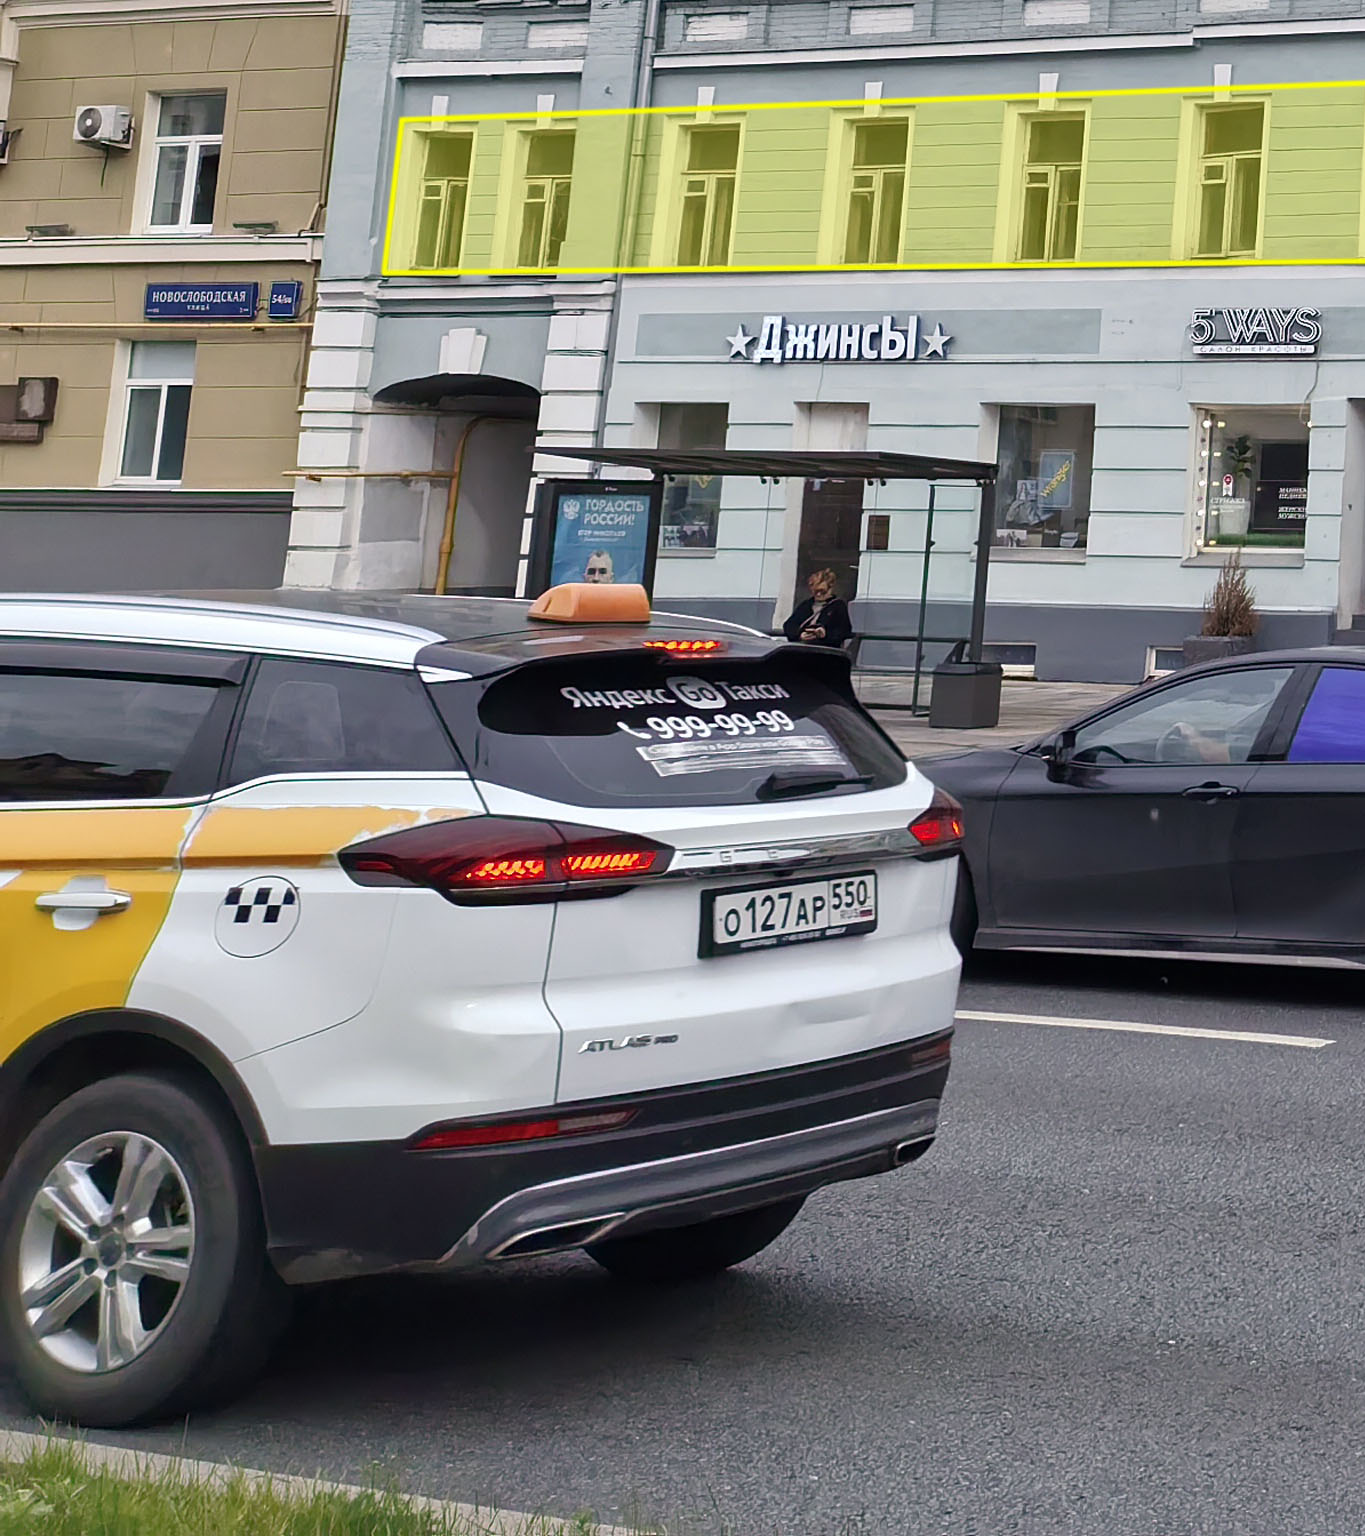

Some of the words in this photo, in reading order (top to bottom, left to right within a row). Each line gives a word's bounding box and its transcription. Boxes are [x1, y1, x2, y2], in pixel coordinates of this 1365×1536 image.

[152, 291, 246, 303] НОВОСЛОБОДСКАЯ
[1189, 308, 1216, 344] 5
[1222, 307, 1323, 344] WAYS
[583, 513, 636, 526] РОССИИ!
[585, 499, 645, 512] ГОРДОСТЬ
[559, 686, 677, 710] Яндекс
[713, 681, 791, 702] Такси
[645, 710, 796, 740] 999-99-99
[723, 891, 826, 937] О127АР
[832, 879, 868, 911] 550
